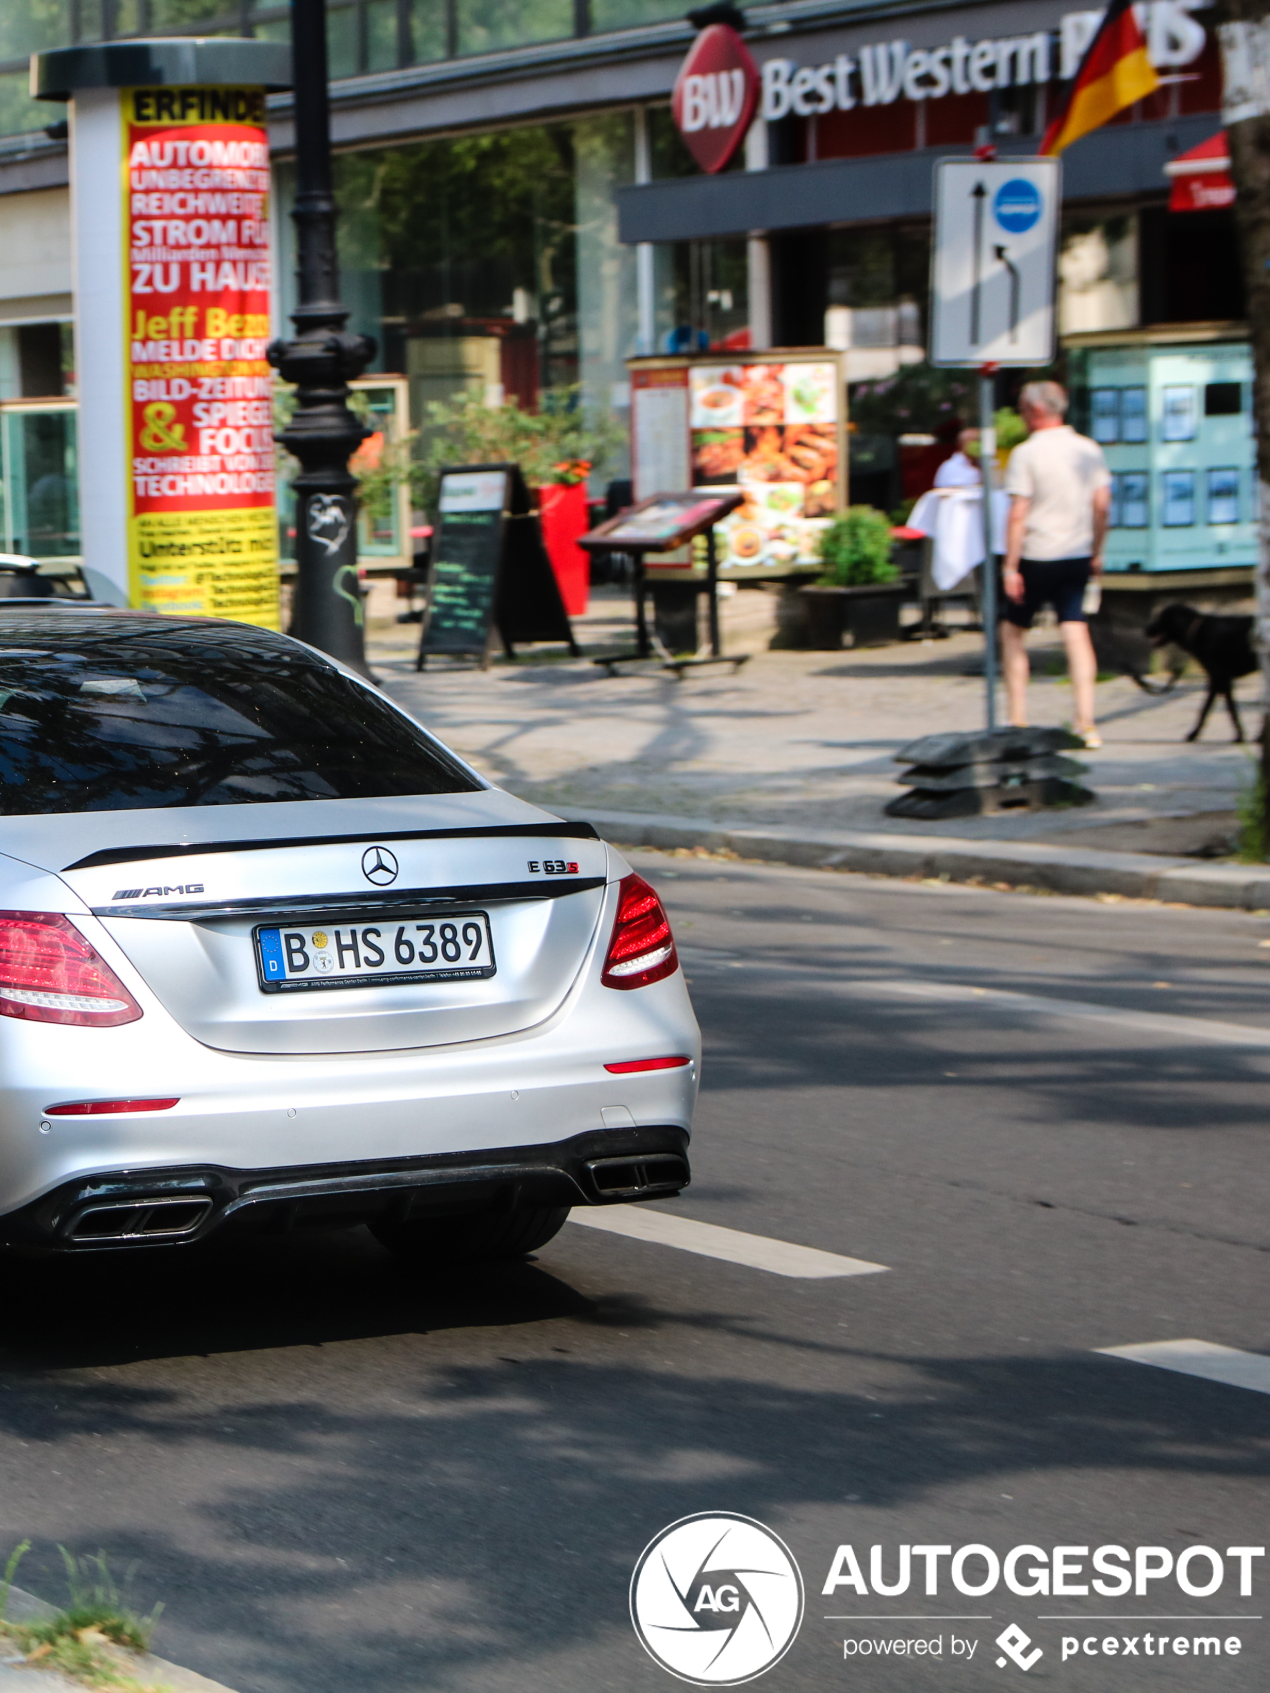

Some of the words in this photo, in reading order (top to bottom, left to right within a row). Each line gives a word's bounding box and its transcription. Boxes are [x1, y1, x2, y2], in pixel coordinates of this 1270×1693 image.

[762, 58, 856, 121] Best
[861, 33, 1050, 107] Western
[682, 70, 745, 132] BW
[132, 219, 237, 247] STROM
[132, 262, 181, 293] ZU
[131, 306, 198, 340] Jeff
[132, 339, 218, 362] MELDE
[140, 402, 188, 452] &
[527, 860, 541, 873] E
[142, 883, 205, 898] AMG
[284, 933, 310, 973] B
[334, 927, 385, 969] HS
[394, 922, 482, 965] 6389
[268, 959, 278, 972] D
